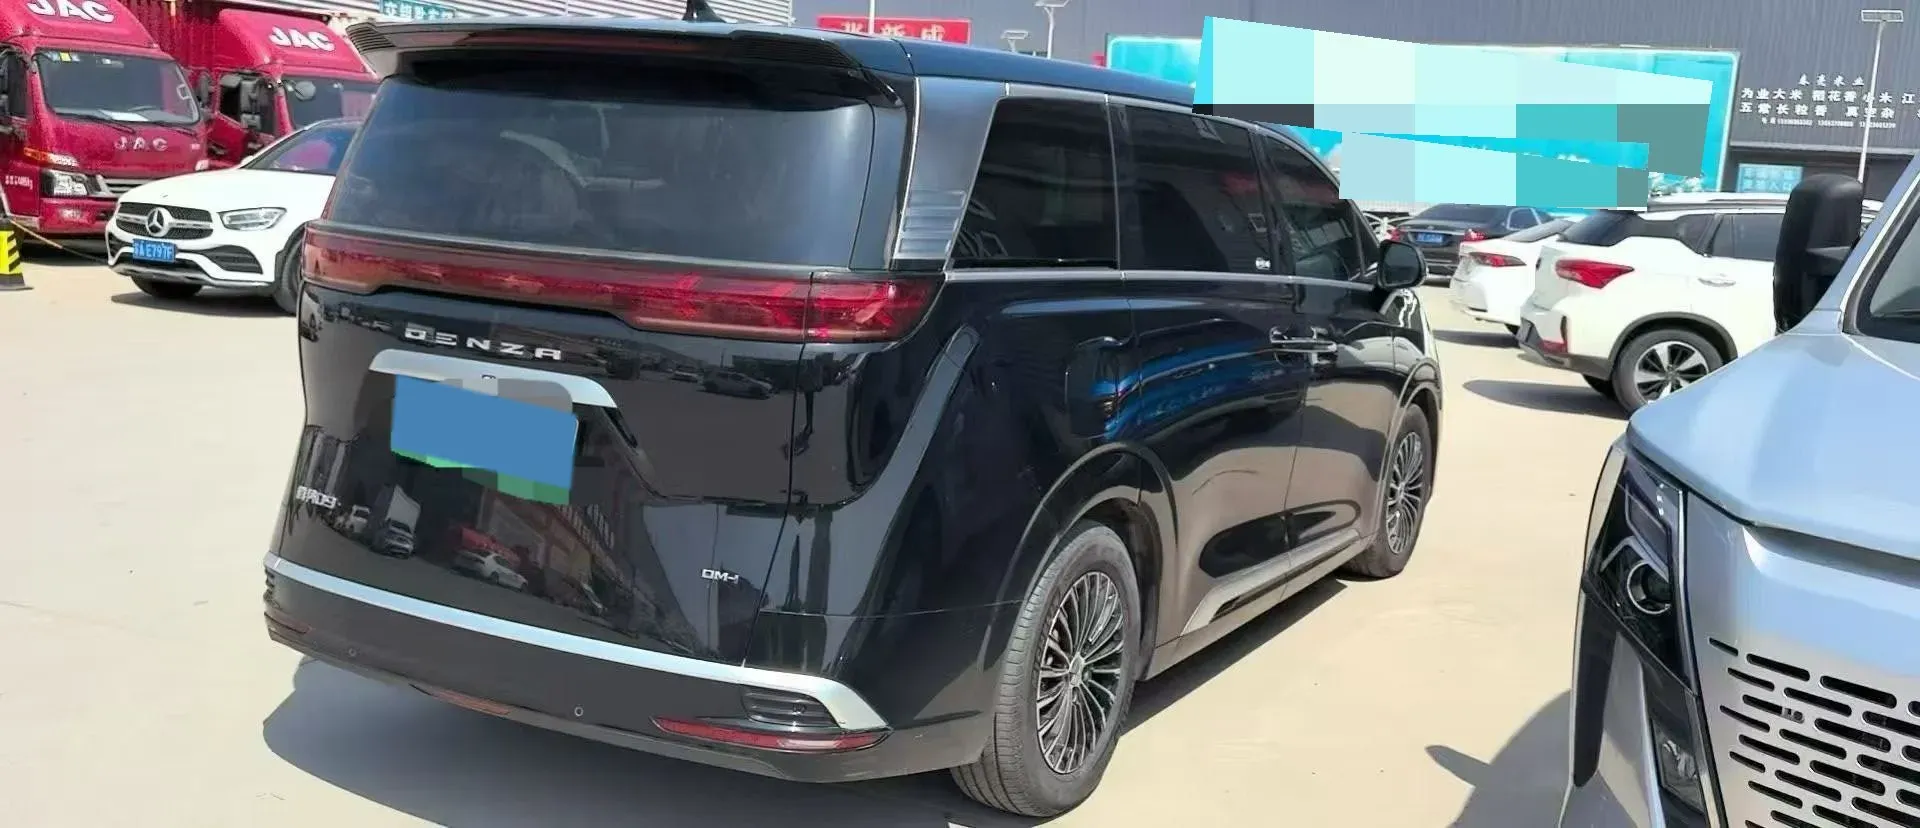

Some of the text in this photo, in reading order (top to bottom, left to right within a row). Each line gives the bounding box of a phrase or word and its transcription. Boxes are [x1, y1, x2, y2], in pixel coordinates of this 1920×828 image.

[26, 0, 115, 23] JAC
[268, 25, 335, 51] JAC
[114, 136, 168, 152] JAC
[404, 325, 562, 361] DENZA
